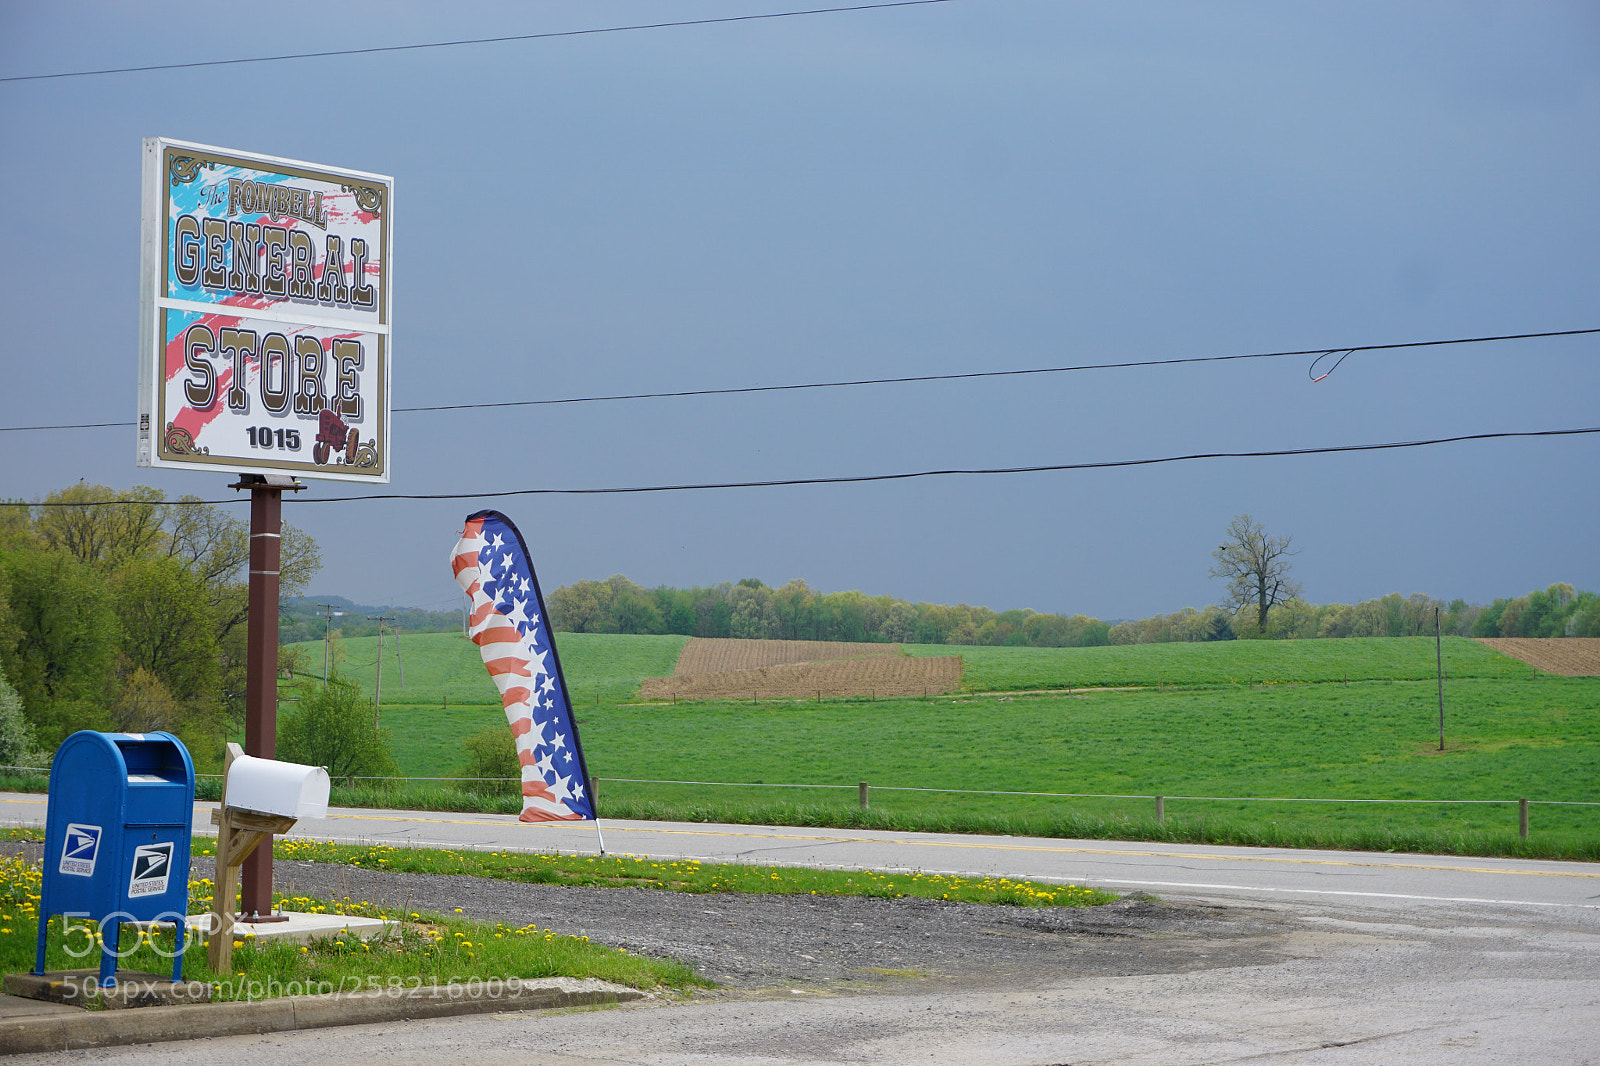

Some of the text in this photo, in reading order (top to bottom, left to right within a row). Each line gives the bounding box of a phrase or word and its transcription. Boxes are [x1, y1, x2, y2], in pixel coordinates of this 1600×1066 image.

[198, 178, 327, 230] The FOMBELL
[175, 214, 374, 306] GENERAL
[184, 324, 361, 418] STORE
[246, 426, 301, 449] 1015
